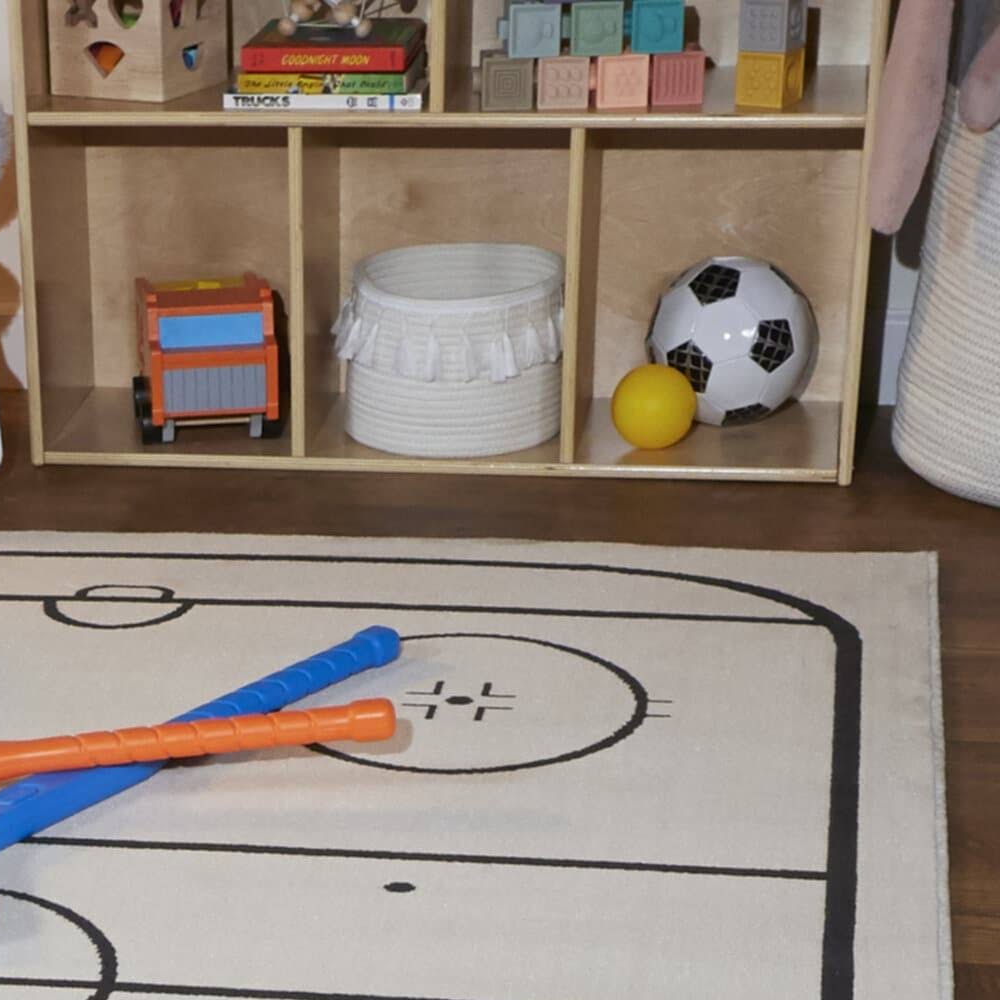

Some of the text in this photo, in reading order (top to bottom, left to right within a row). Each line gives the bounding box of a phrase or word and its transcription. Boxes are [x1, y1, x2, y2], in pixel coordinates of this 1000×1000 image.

[281, 54, 370, 66] GOODNIGHT MOON
[232, 95, 291, 108] TRUCKS
